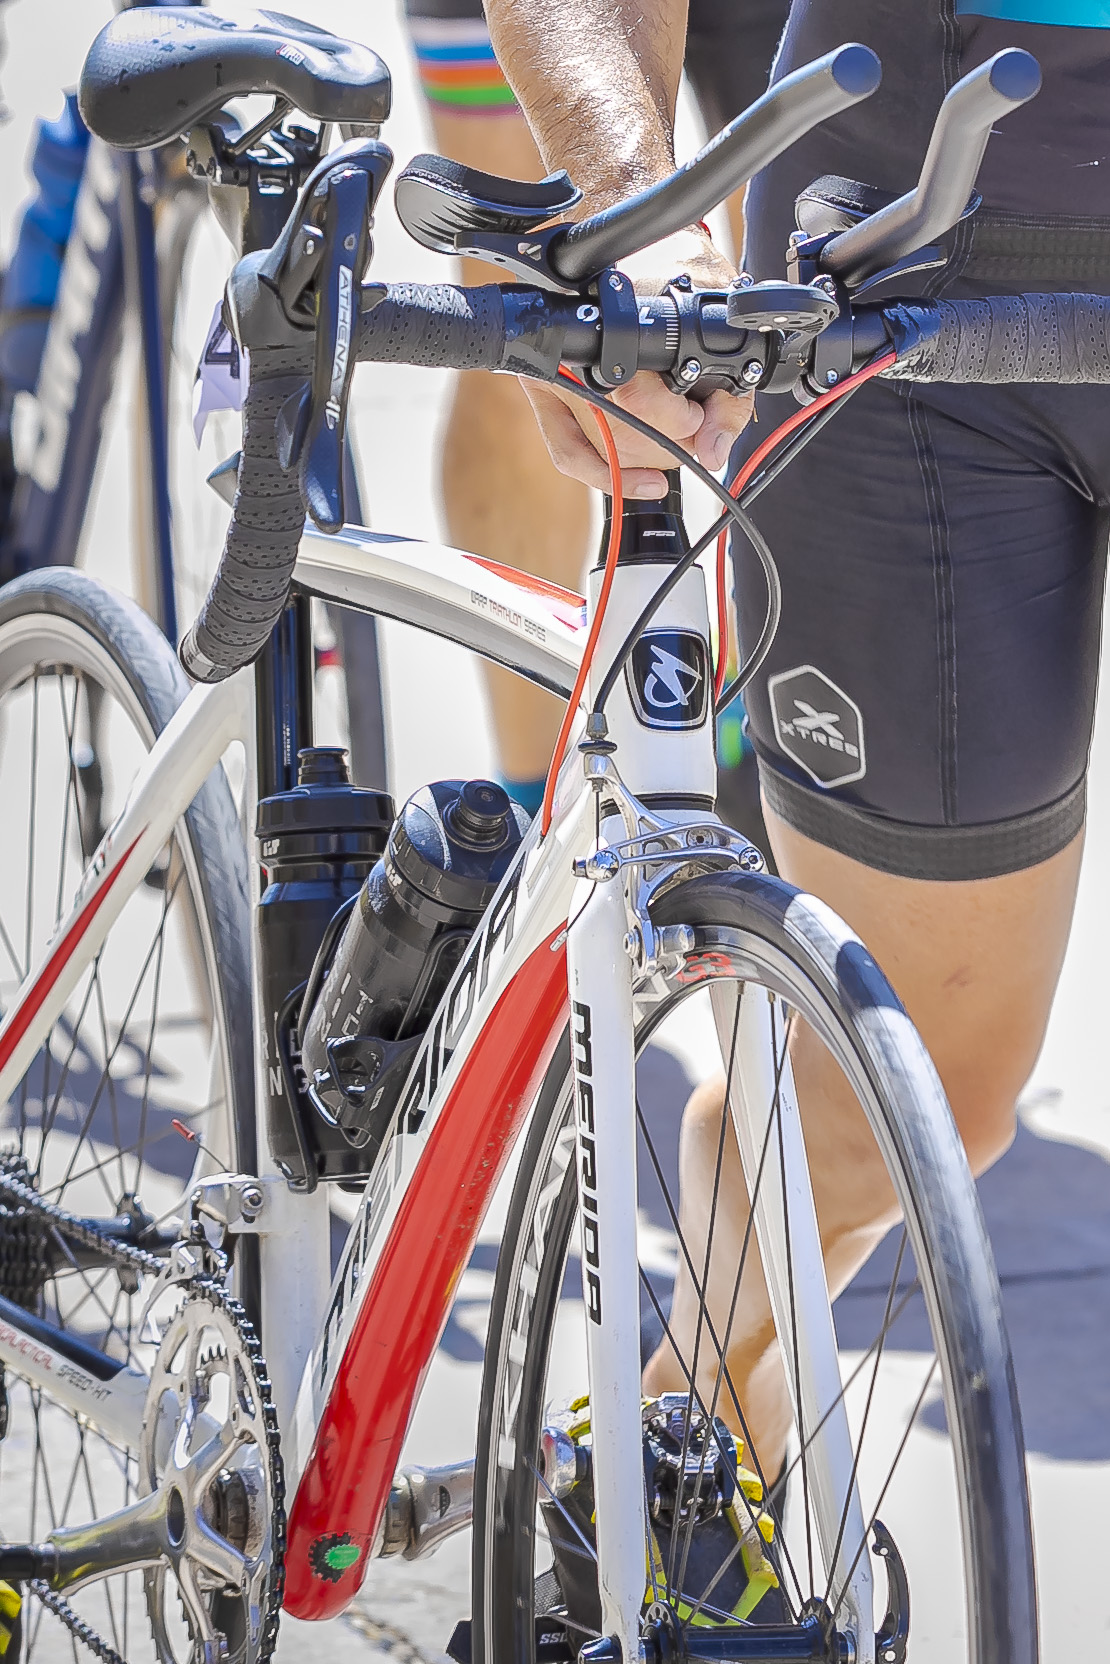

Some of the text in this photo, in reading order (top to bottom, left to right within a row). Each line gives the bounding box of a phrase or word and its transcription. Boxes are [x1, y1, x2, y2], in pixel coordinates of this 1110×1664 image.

[331, 268, 352, 384] ATHENA
[488, 598, 522, 627] TRIATHLON
[572, 999, 603, 1327] MERIDA
